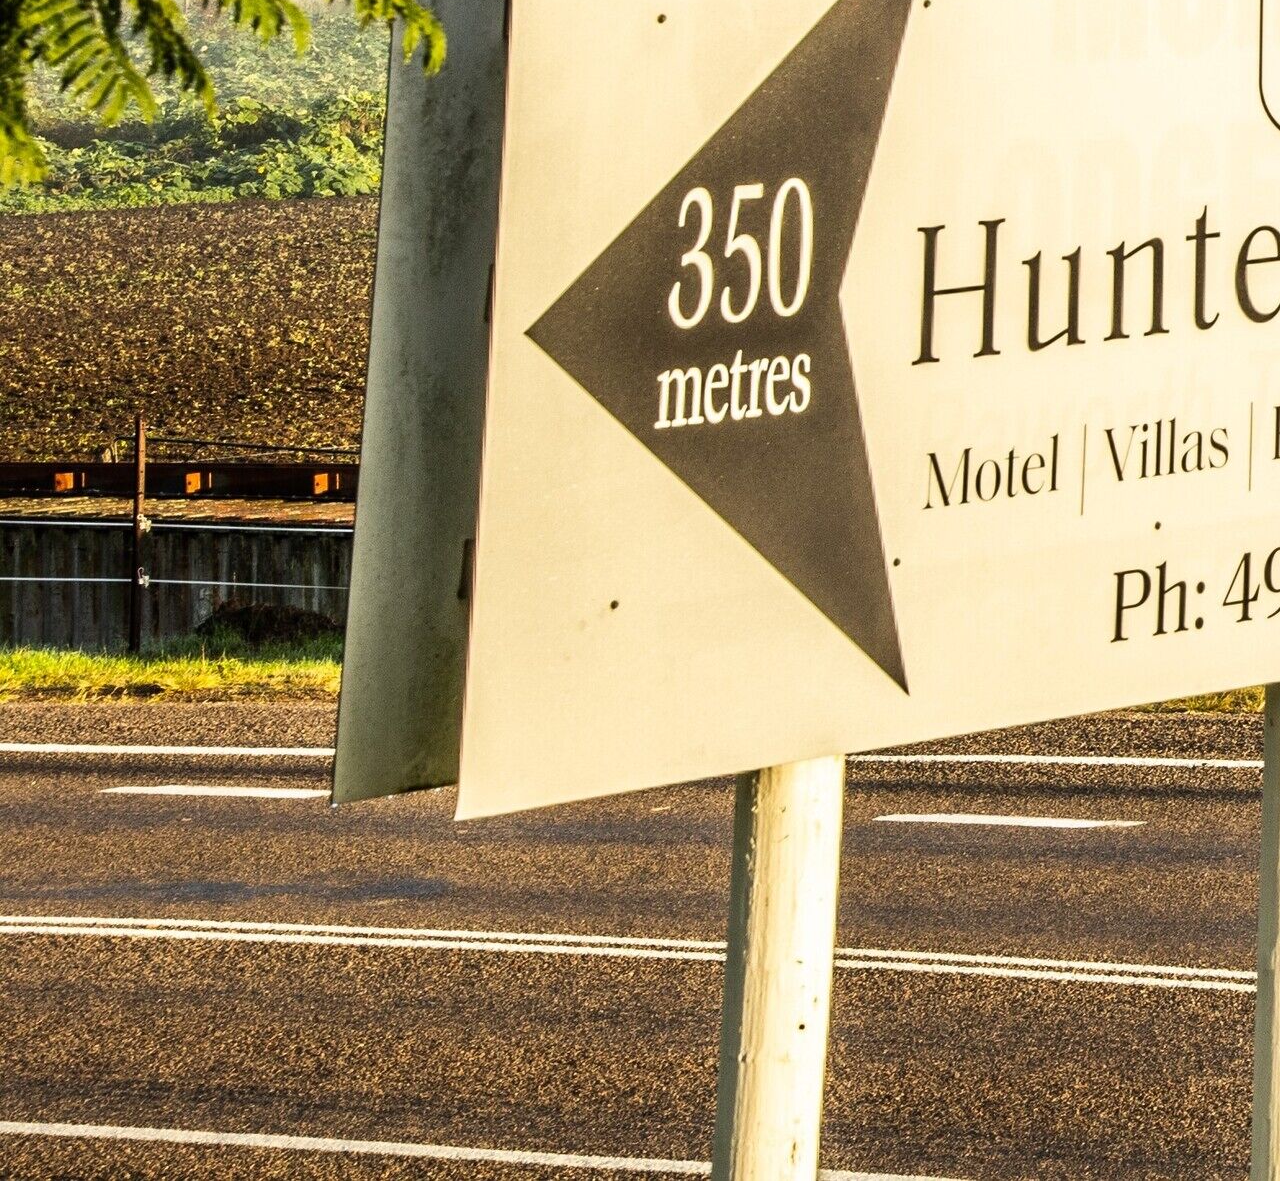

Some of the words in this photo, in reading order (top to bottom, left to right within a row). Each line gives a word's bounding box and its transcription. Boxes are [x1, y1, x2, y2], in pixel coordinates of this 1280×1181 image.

[666, 175, 816, 331] 350
[651, 349, 813, 432] metres
[922, 432, 1061, 511] Motel
[1103, 416, 1230, 483] Villas
[1109, 559, 1207, 645] Ph:
